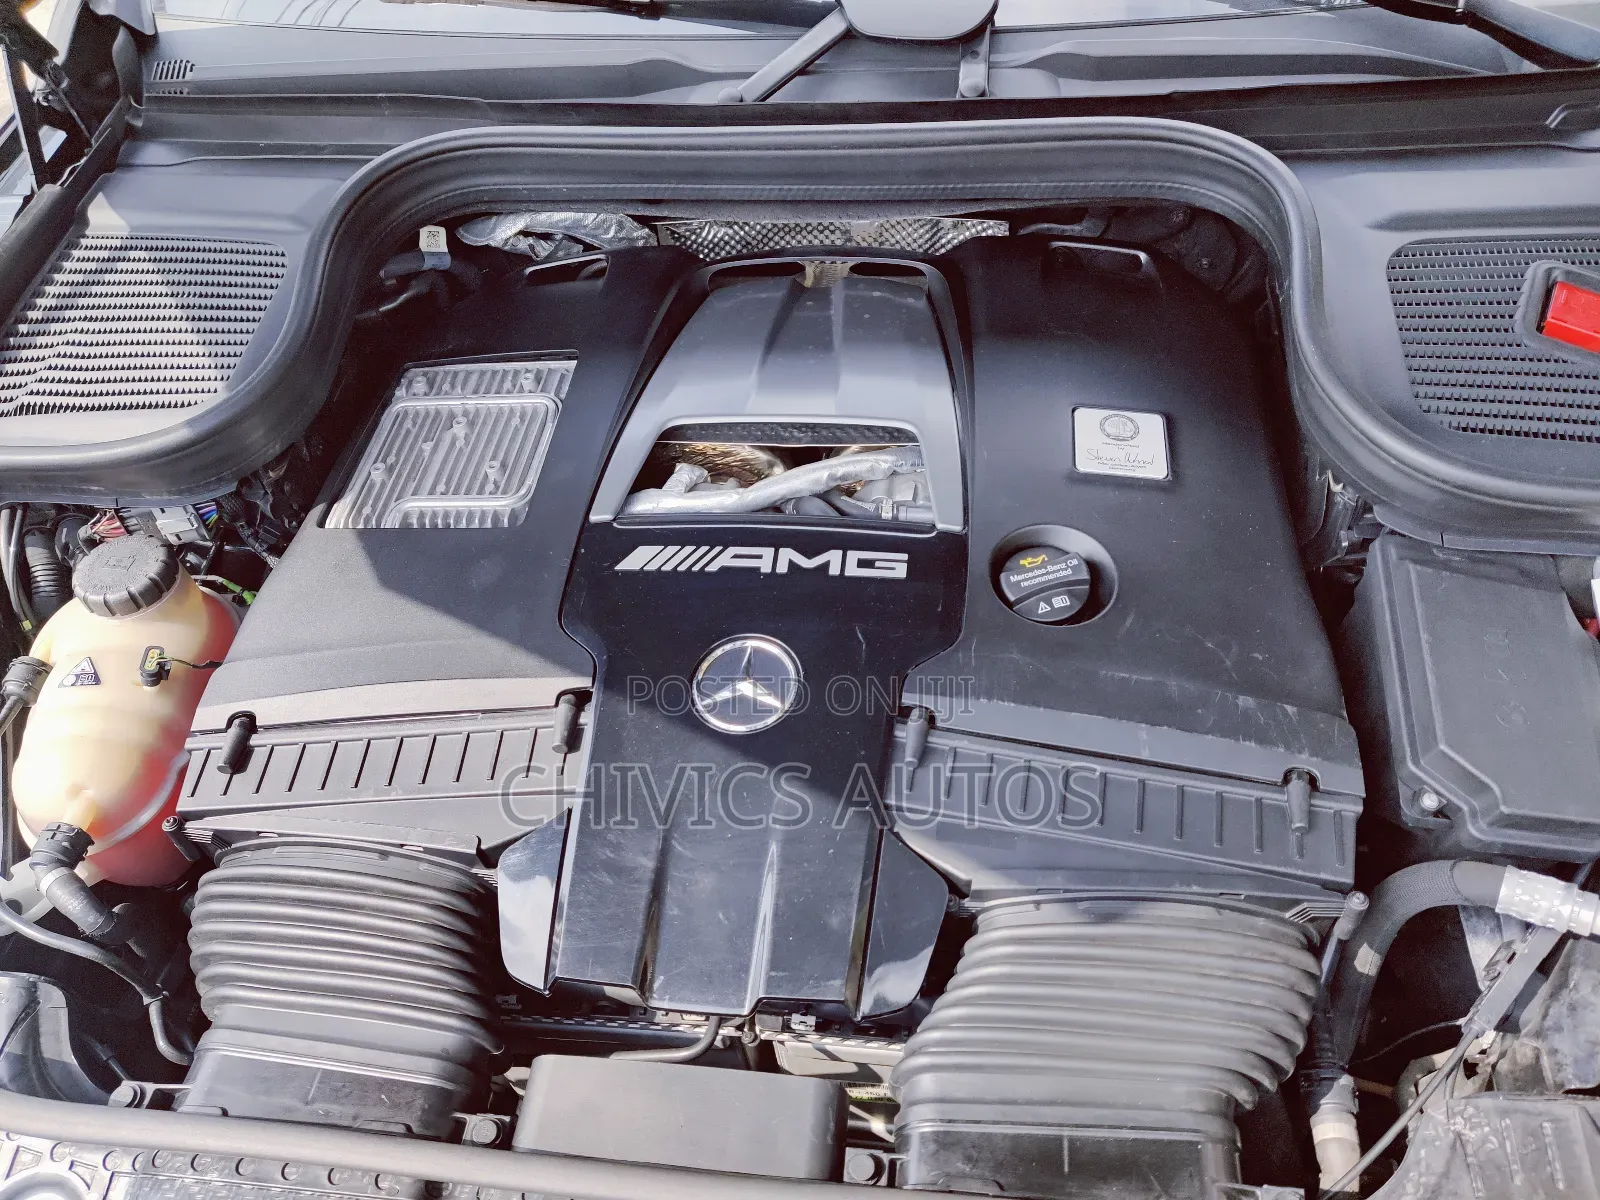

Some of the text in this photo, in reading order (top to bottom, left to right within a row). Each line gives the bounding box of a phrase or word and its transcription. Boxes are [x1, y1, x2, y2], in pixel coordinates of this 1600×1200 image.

[704, 545, 909, 579] AMG
[1009, 558, 1079, 583] Mercedes-Benz Oil
[1020, 568, 1073, 588] recommended
